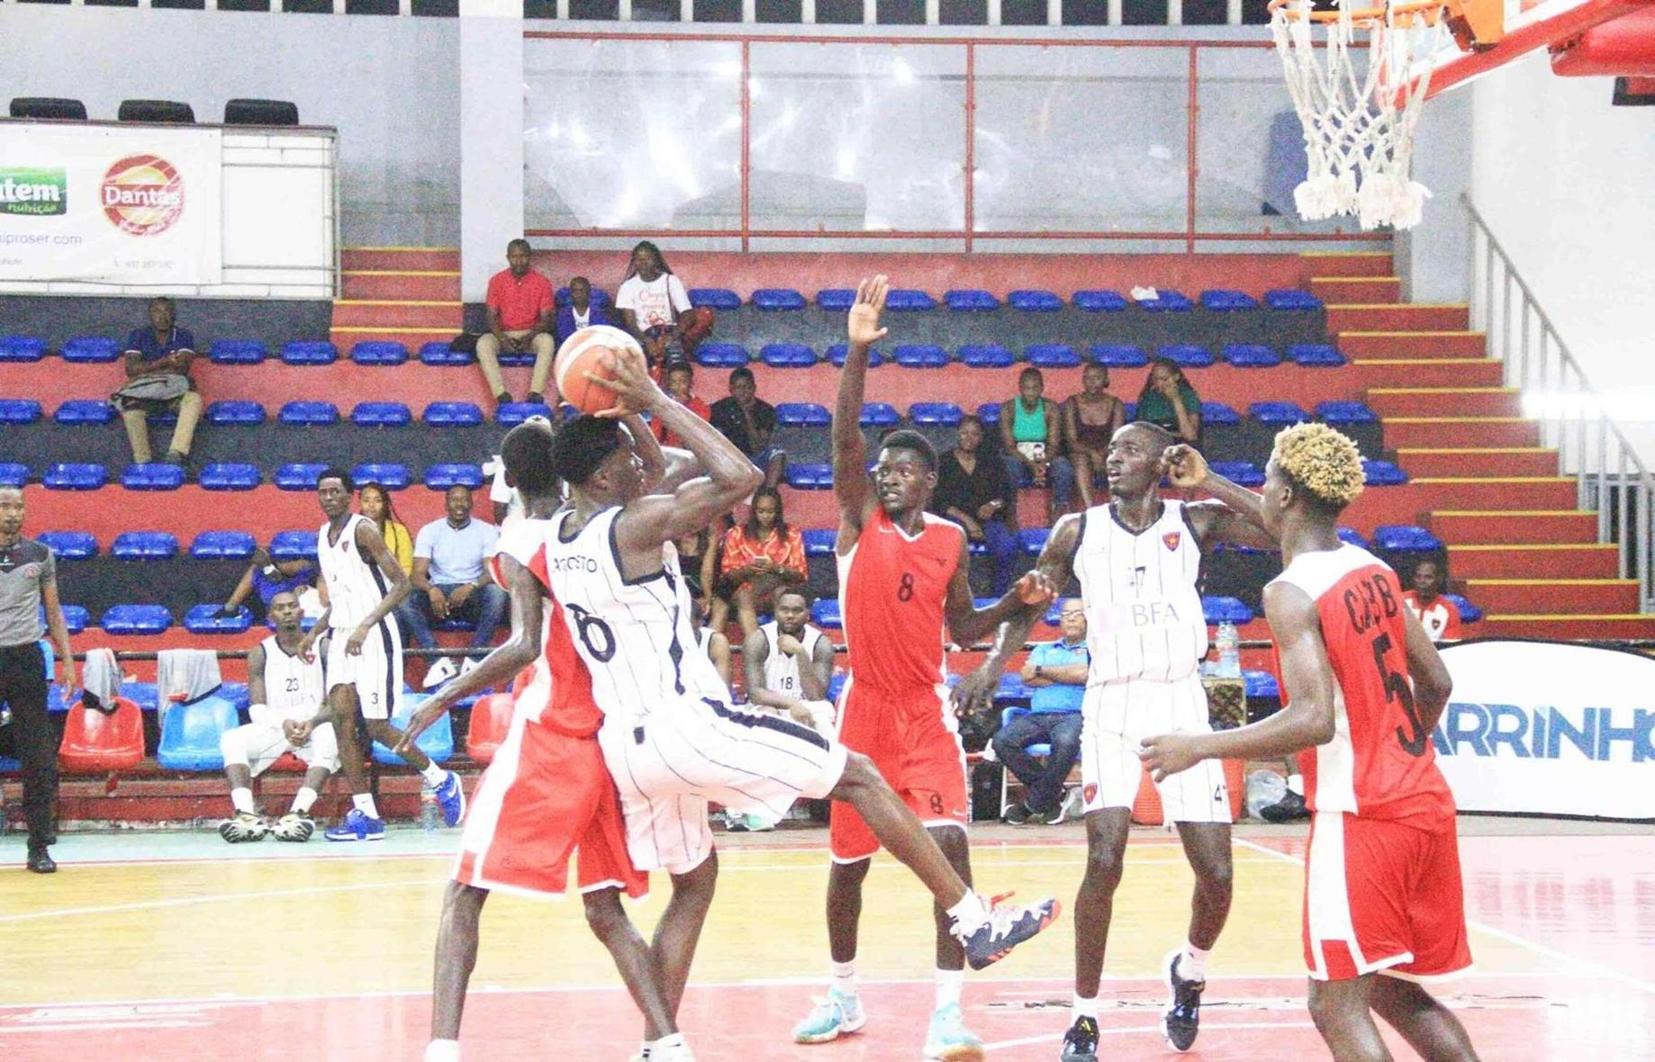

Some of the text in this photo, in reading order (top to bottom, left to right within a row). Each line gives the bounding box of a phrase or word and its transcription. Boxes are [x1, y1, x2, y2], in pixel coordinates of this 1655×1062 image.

[104, 186, 179, 207] Dantas
[898, 572, 915, 602] 8
[1131, 602, 1180, 627] BFA
[285, 678, 300, 692] 23
[780, 676, 794, 690] 18
[370, 692, 379, 705] 3
[1371, 631, 1427, 758] 5
[930, 793, 944, 815] 8
